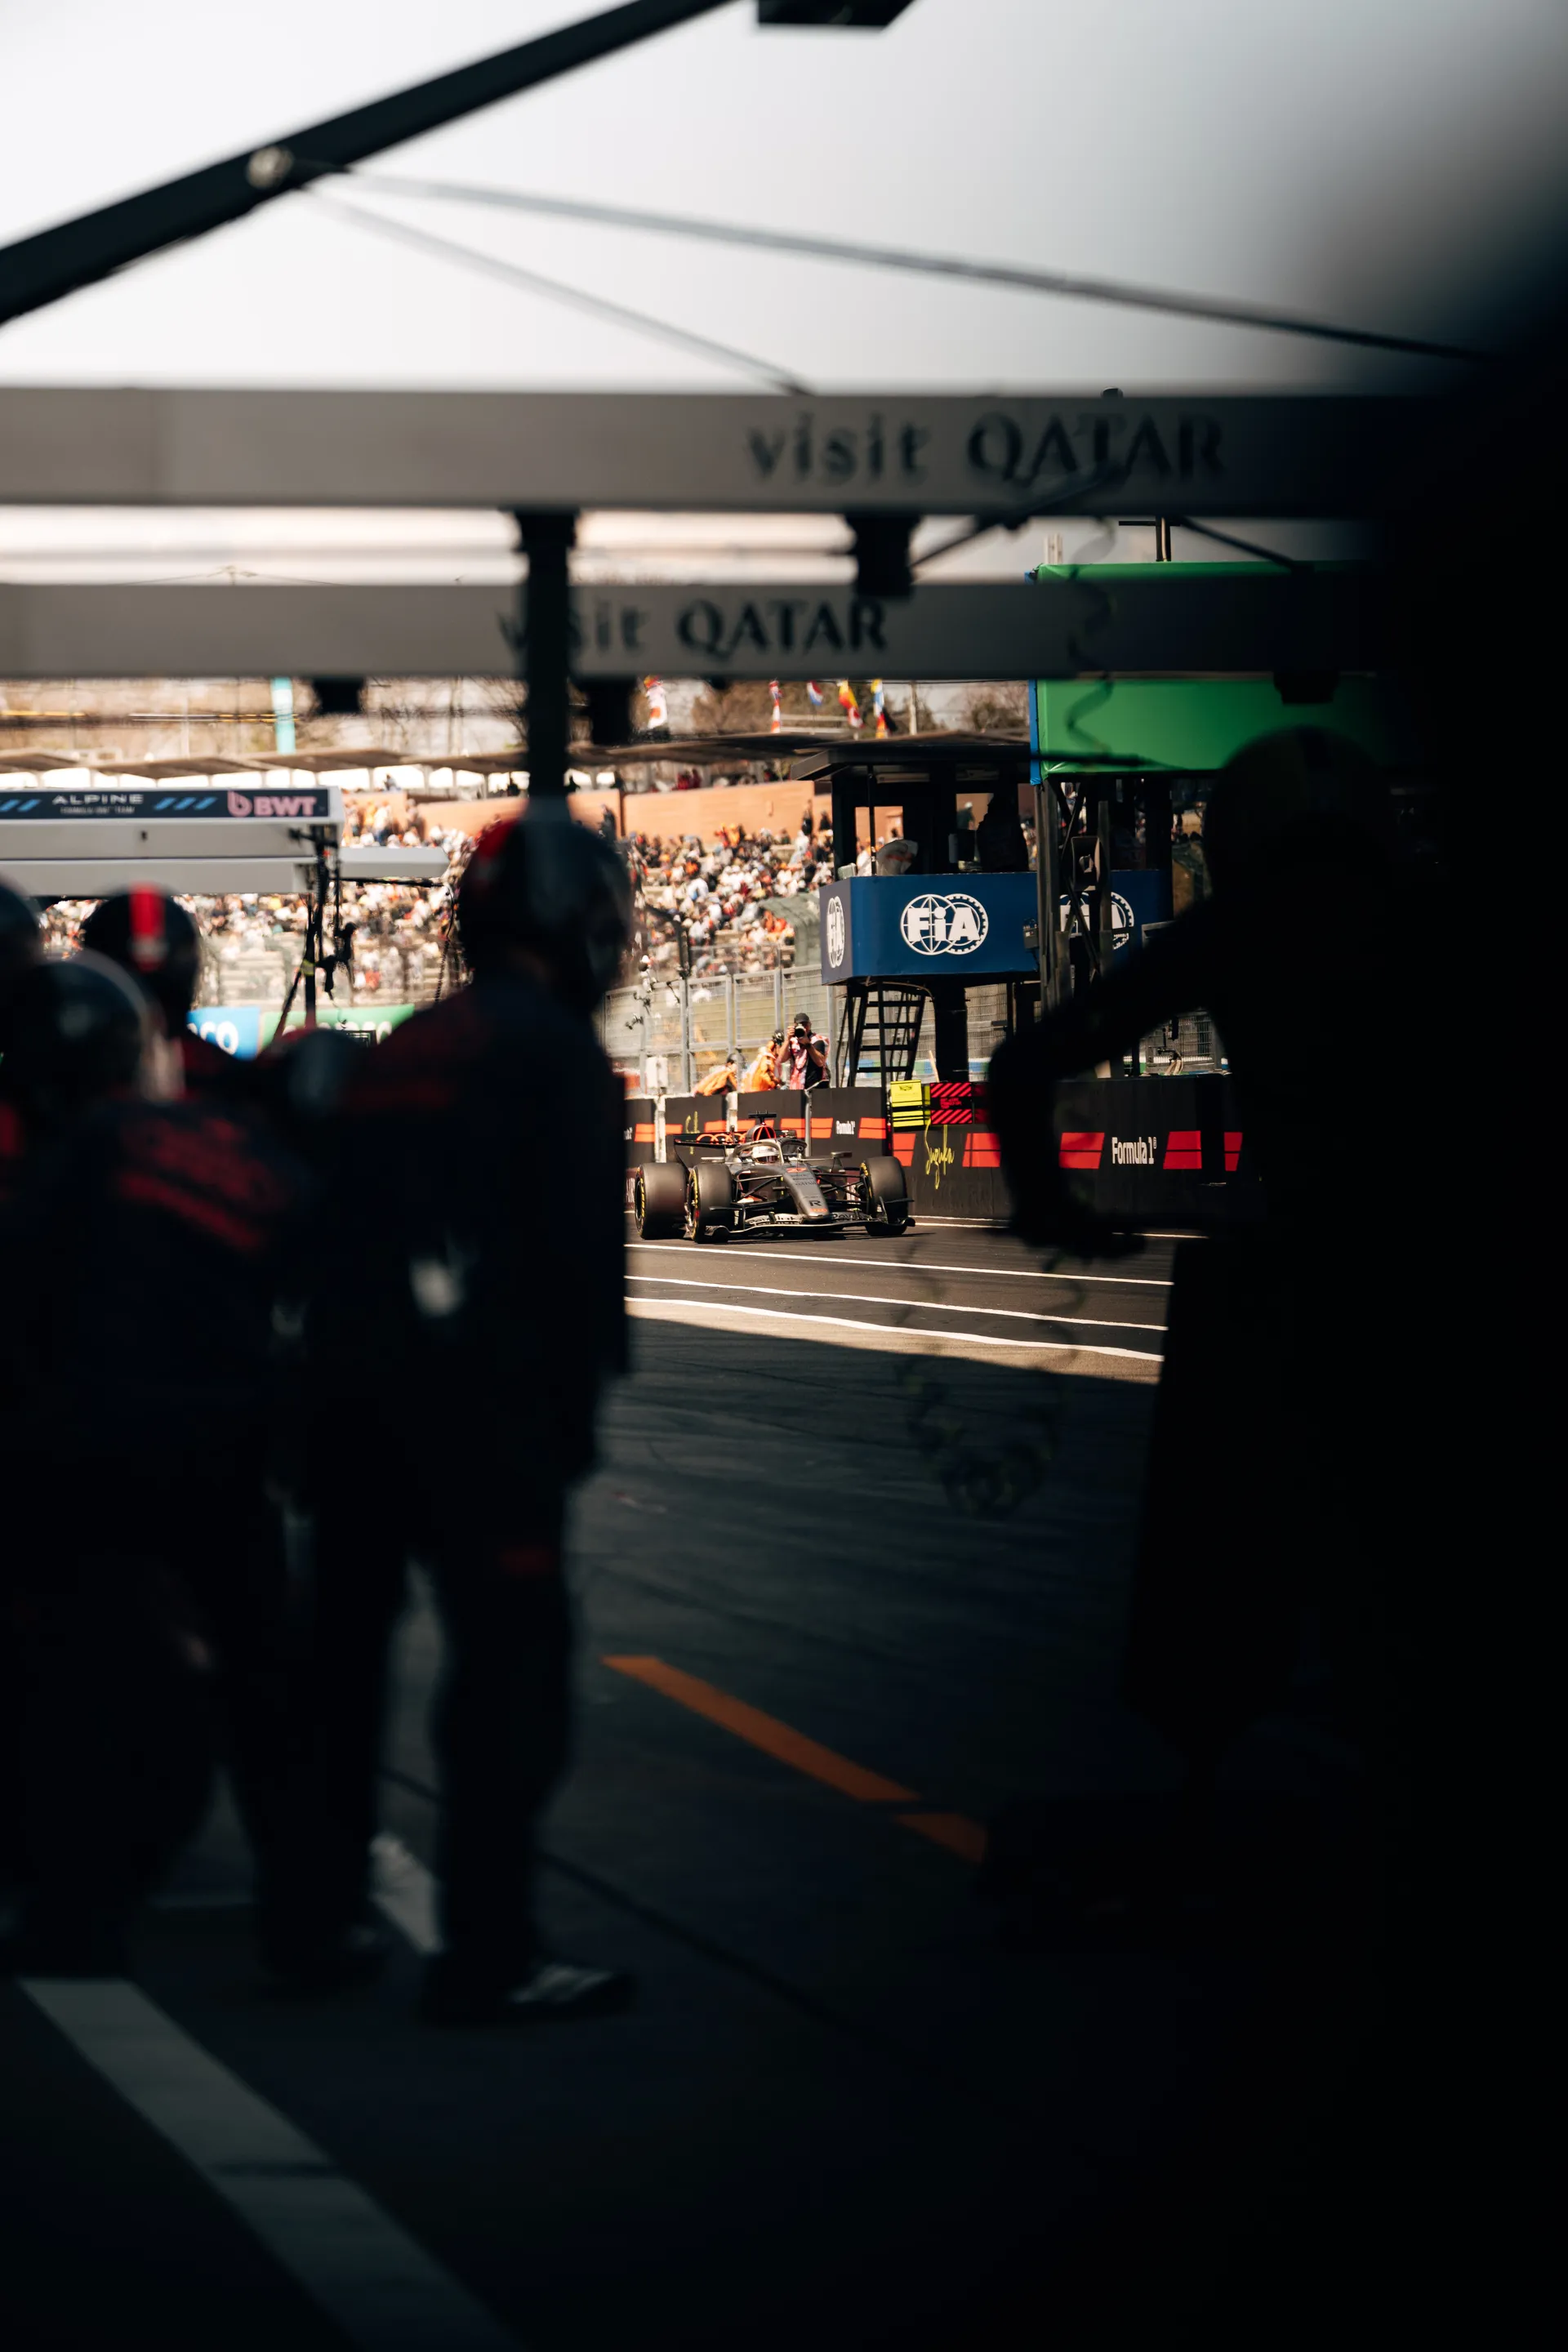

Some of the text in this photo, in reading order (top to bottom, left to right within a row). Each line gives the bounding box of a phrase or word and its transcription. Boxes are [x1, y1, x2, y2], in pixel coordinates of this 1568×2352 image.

[746, 412, 1225, 488] visit QATAR
[497, 599, 889, 659] vsit QATAR
[51, 794, 317, 817] ALPINE BWT
[1111, 1136, 1147, 1165] Formula
